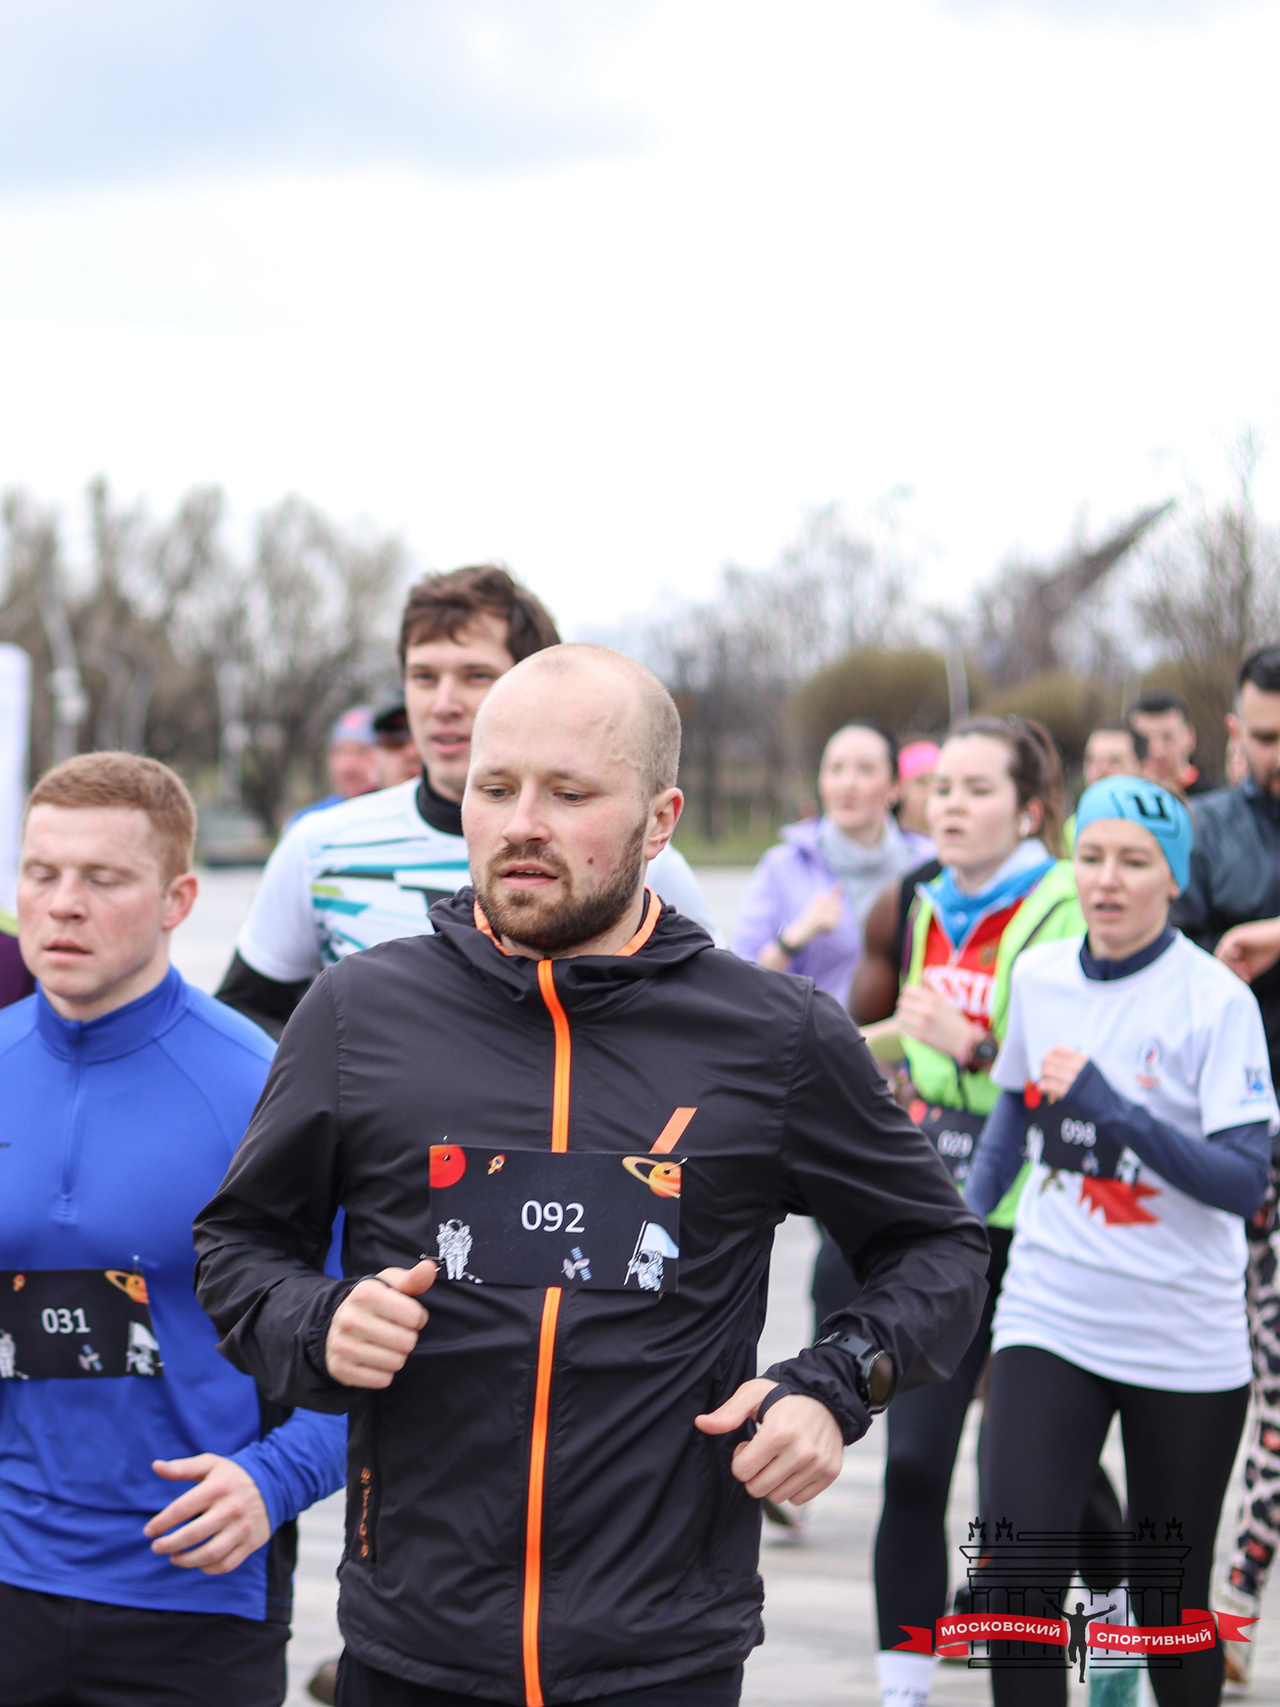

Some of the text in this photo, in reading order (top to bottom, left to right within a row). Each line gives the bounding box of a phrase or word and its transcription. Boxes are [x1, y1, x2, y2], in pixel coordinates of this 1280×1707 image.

[1061, 1117, 1097, 1147] 098
[521, 1200, 585, 1233] 092
[41, 1307, 90, 1334] 031
